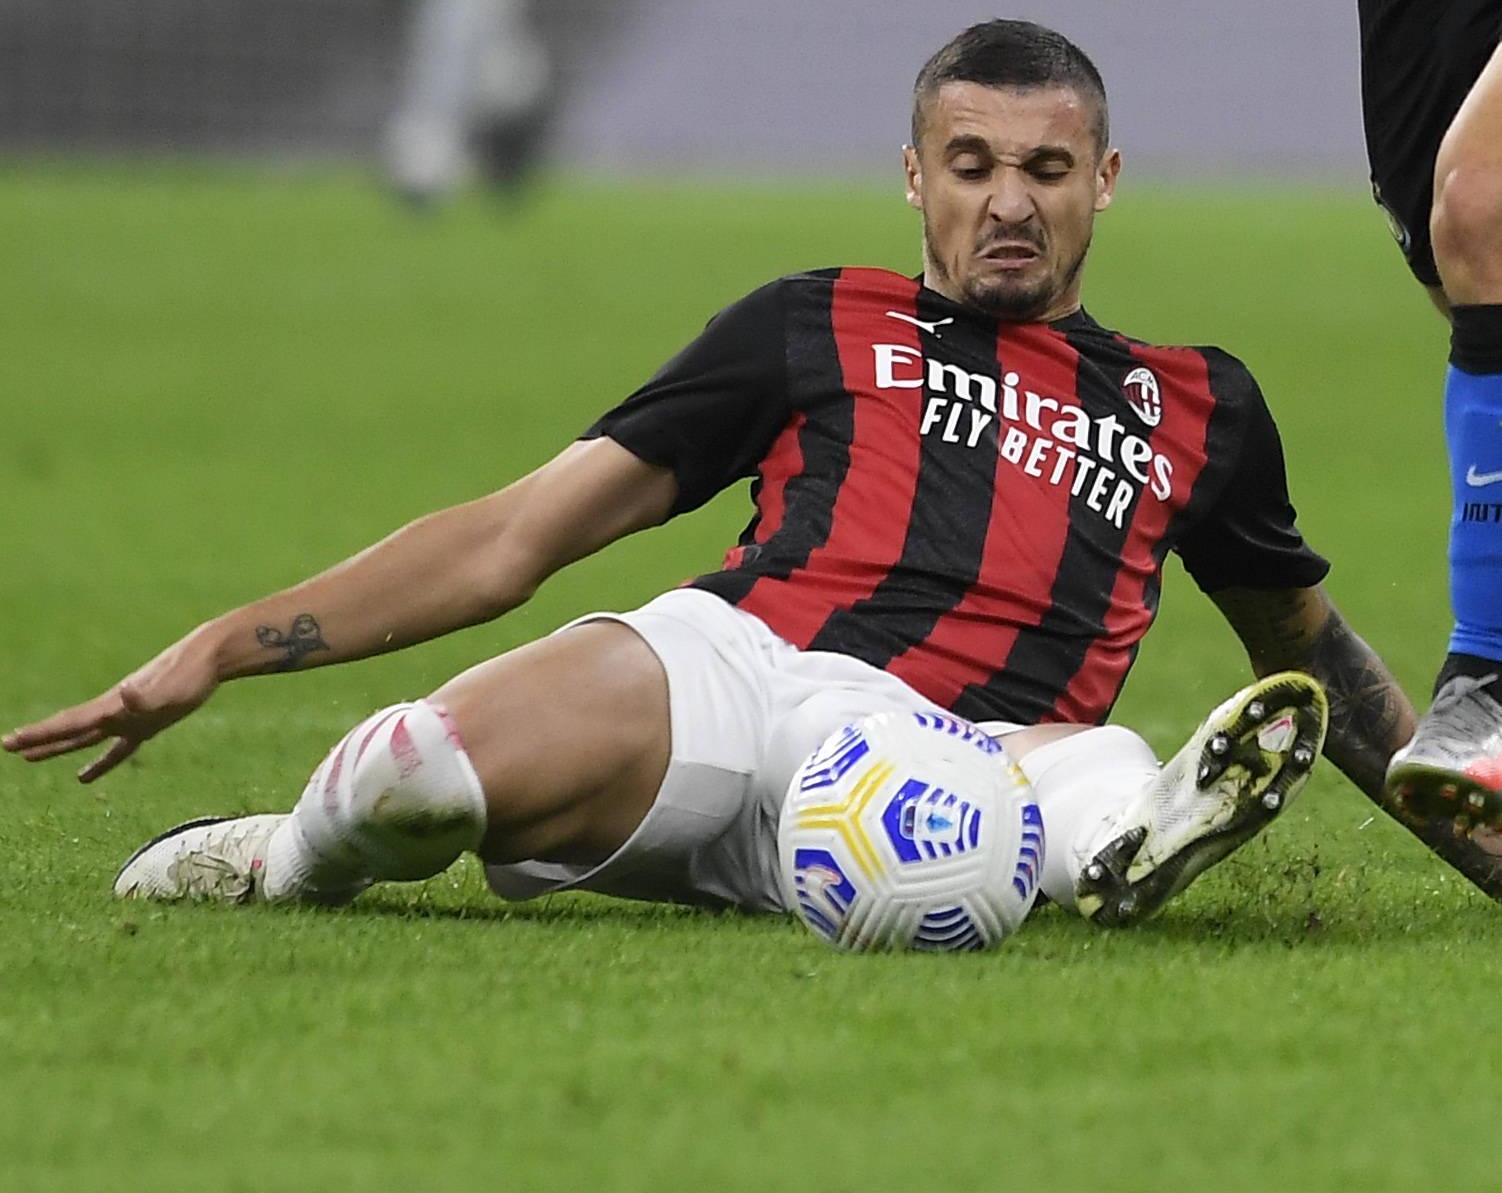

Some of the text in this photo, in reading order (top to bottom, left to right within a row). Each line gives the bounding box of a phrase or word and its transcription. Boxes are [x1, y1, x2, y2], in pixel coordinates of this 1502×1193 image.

[872, 343, 1174, 502] Emirates
[920, 397, 1136, 529] FLY BETTER
